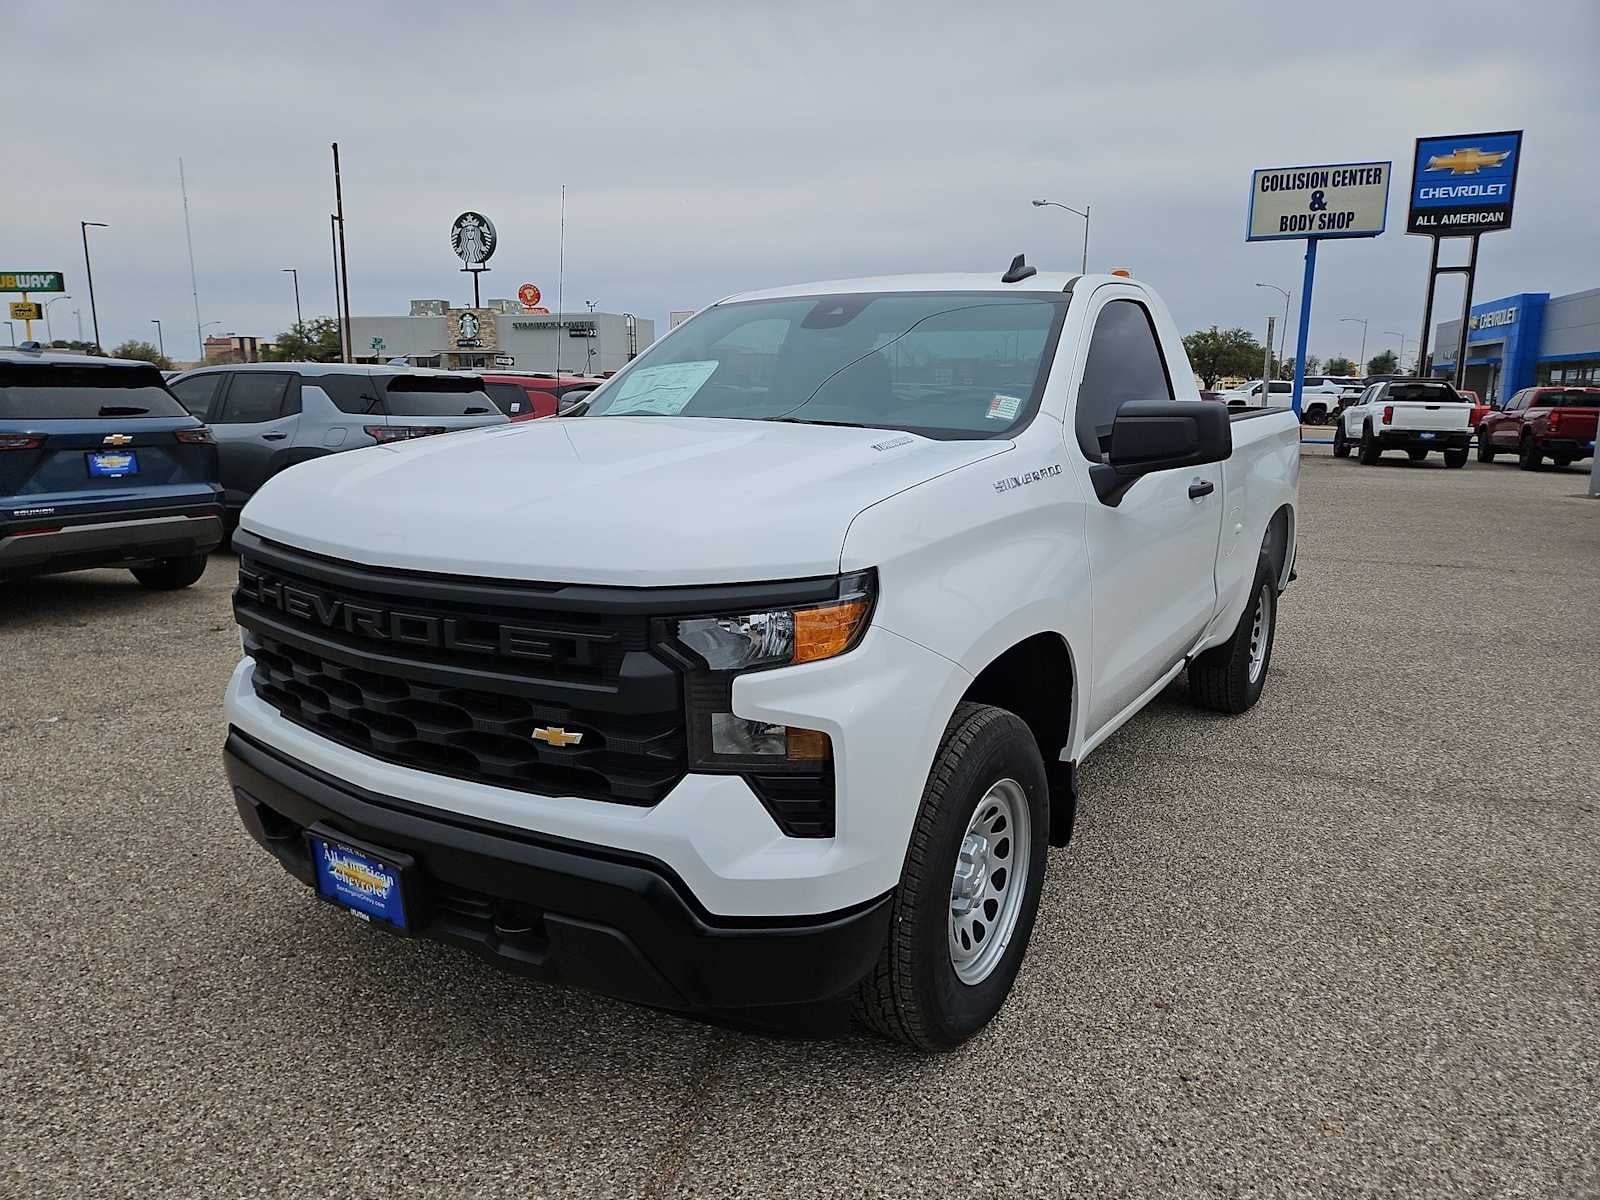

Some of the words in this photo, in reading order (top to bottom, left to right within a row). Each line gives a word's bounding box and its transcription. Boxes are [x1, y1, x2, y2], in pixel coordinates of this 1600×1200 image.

[1261, 172, 1328, 192] COLLISION
[1332, 168, 1382, 187] CENTER
[1309, 190, 1327, 211] &
[1420, 184, 1506, 199] CHEVROLET
[1280, 214, 1316, 232] BODY
[1318, 212, 1355, 230] SHOP
[1416, 215, 1437, 226] ALL
[1441, 212, 1504, 225] AMERICAN
[0, 275, 54, 288] UBWAY
[1480, 307, 1517, 329] CHEVROLET
[994, 464, 1062, 493] SILVERADO
[239, 568, 617, 665] CHEVROLET
